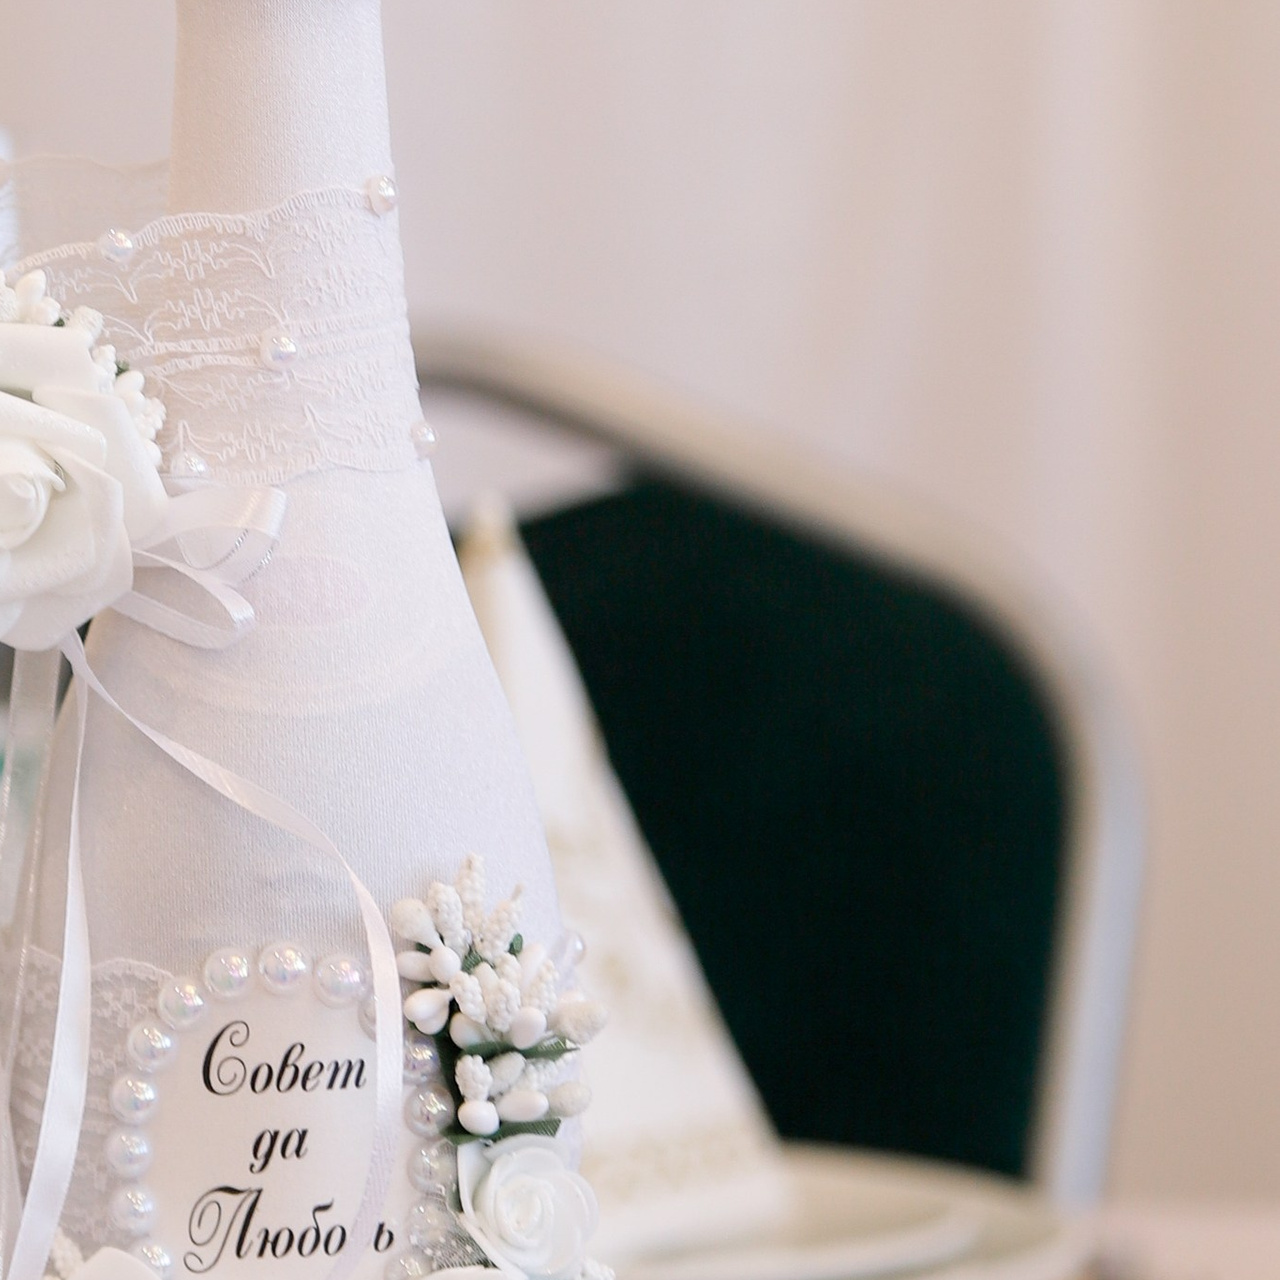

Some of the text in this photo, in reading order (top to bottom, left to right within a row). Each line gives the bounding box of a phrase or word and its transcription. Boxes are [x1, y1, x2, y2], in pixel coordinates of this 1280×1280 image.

[201, 1020, 367, 1097] Совет
[249, 1128, 310, 1175] да
[183, 1185, 396, 1274] Любоь
